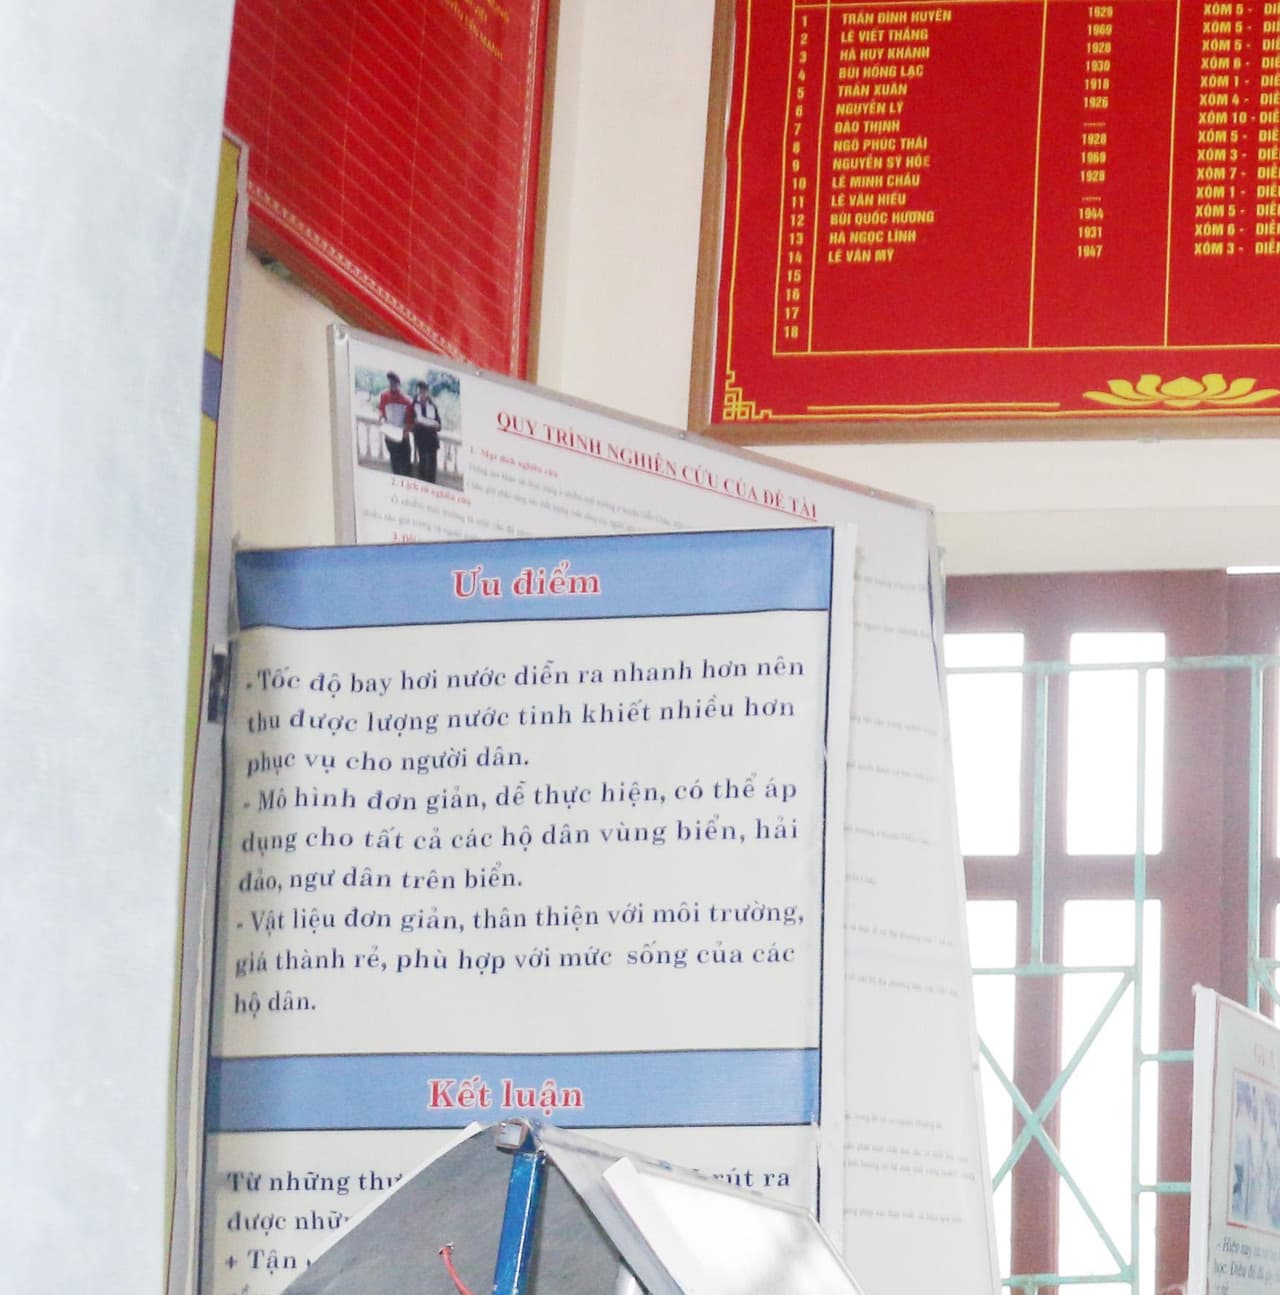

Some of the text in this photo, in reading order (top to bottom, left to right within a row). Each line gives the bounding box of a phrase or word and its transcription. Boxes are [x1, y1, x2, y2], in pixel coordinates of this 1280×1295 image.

[791, 214, 804, 227] 12
[787, 270, 801, 282] 15
[785, 307, 799, 320] 17
[452, 560, 602, 599] Ưu điểm
[257, 655, 804, 699] Tốc độ bay hơi nước diễn ra nhanh hơn nên
[247, 693, 795, 738] thu được lượng nước tinh khiết nhiều hơn
[247, 745, 529, 778] phục vụ cho người dân.
[258, 772, 797, 815] Mô hình đơn giản, dễ thực hiện, có thể áp
[241, 814, 798, 857] dụng cho tất cả các hộ dân vùng biển, hải
[289, 868, 336, 893] ngư
[342, 865, 391, 888] dân
[402, 869, 456, 890] trên
[464, 861, 523, 889] biển.
[251, 900, 804, 937] Vật liệu đơn giản, thân thiện với môi trường,
[235, 940, 795, 978] giá thành rẻ, phù hợp với mức sống của các
[234, 990, 316, 1019] hộ dân.
[428, 1075, 584, 1116] Kết luận
